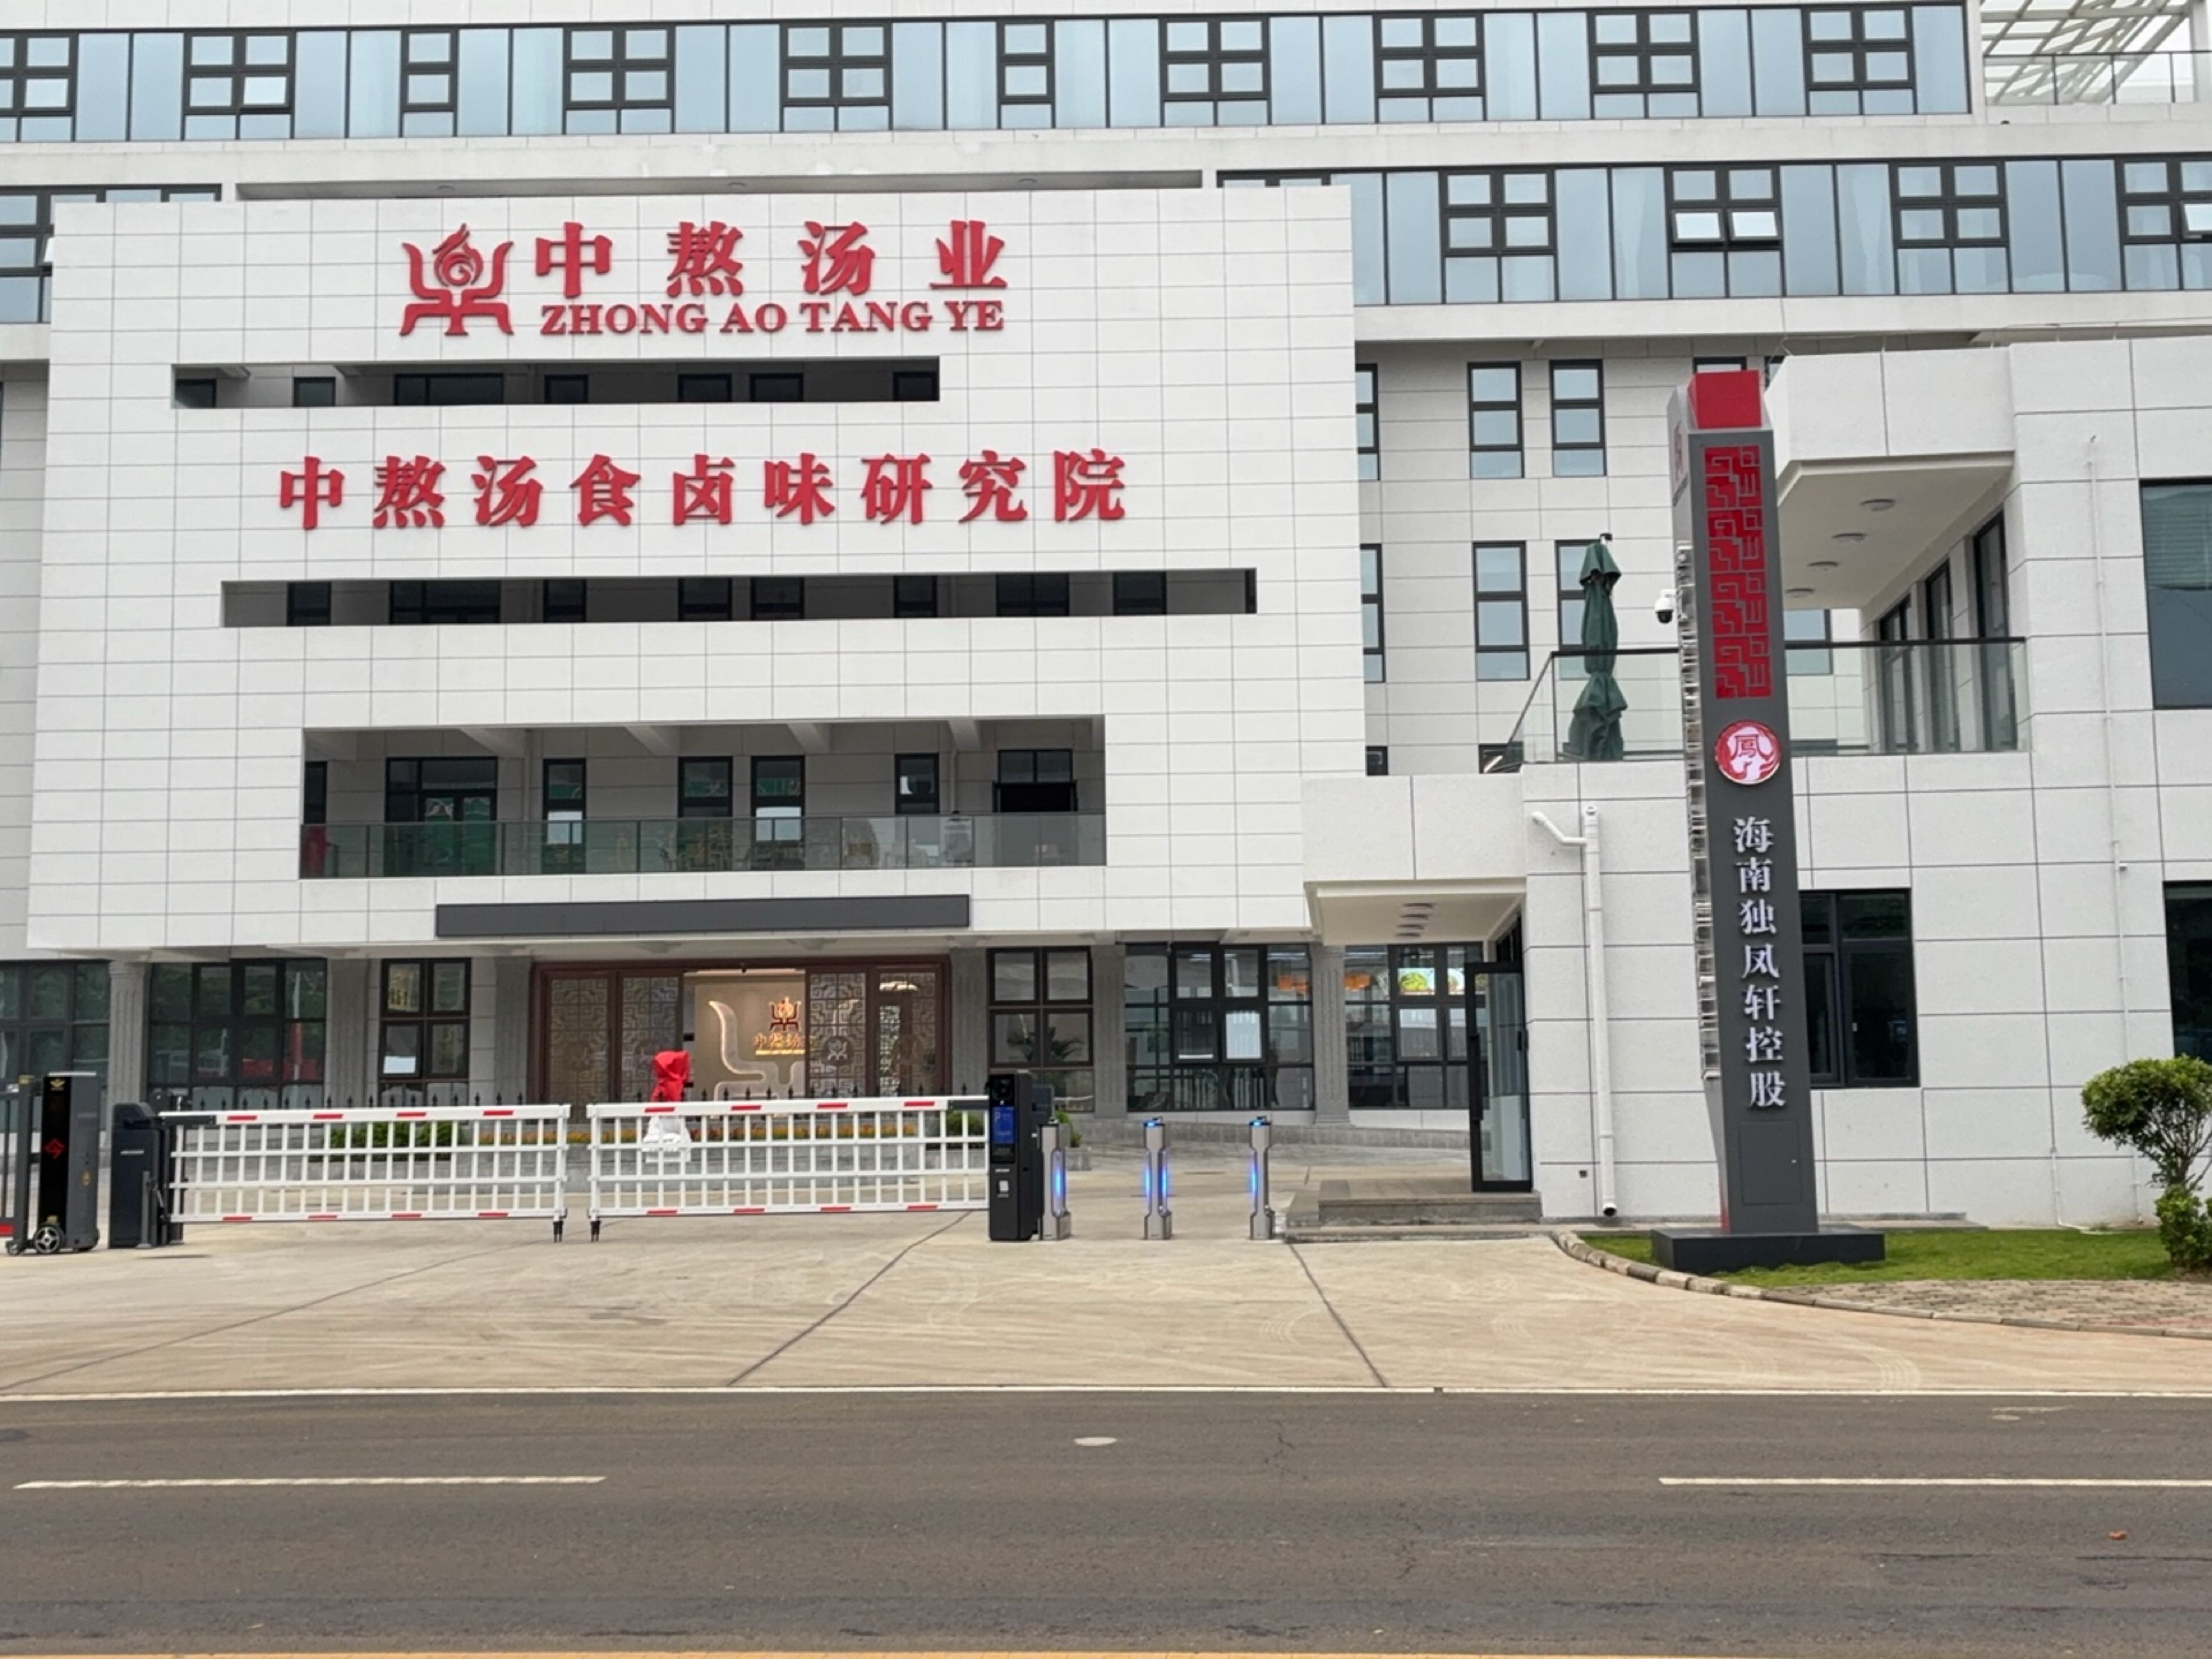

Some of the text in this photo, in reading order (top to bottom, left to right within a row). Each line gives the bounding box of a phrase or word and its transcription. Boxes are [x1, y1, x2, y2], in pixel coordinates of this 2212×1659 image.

[534, 220, 1007, 297] 中熬汤业
[541, 300, 1004, 336] ZHONG AO TANG YE
[278, 447, 1126, 529] 中熬汤食卤味研究院
[1733, 815, 1787, 1109] 海南独凤轩控股
